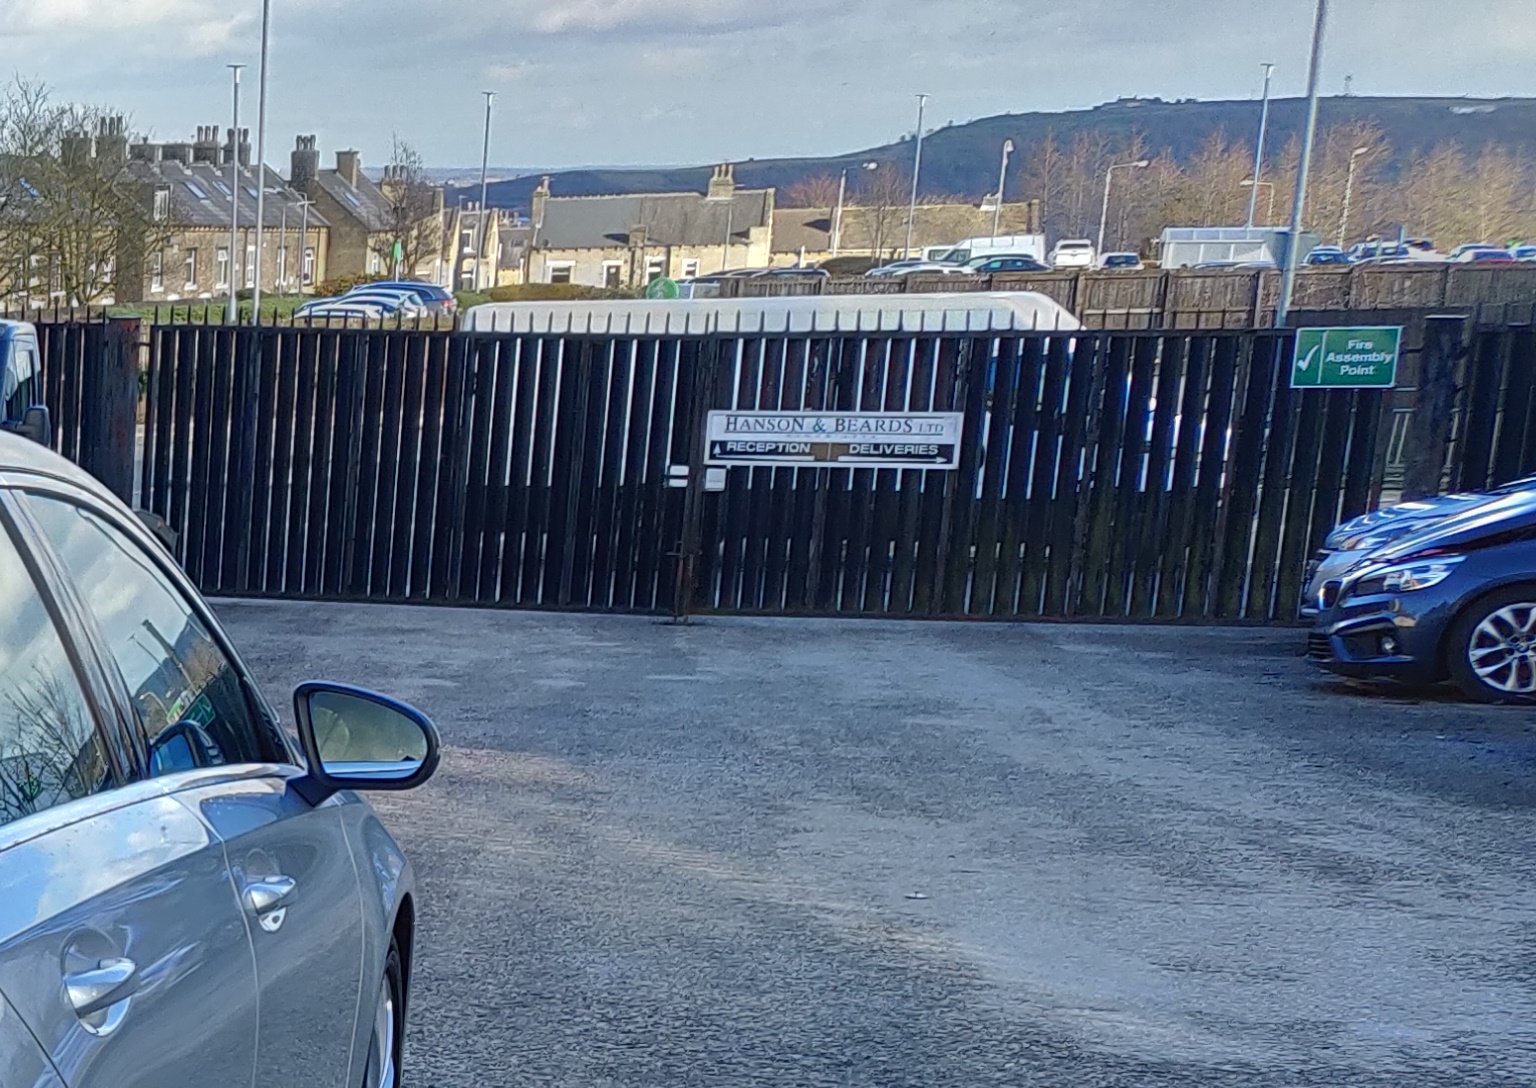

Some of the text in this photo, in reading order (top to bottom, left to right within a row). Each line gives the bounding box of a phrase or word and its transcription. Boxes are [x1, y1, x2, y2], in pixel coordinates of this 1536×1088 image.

[1348, 340, 1373, 350] Fire
[1325, 352, 1394, 364] Assembly
[1339, 365, 1376, 376] Point
[724, 416, 944, 434] HANSON & BEARDS LTD
[726, 441, 939, 456] RECEPTION DELIVERIES
